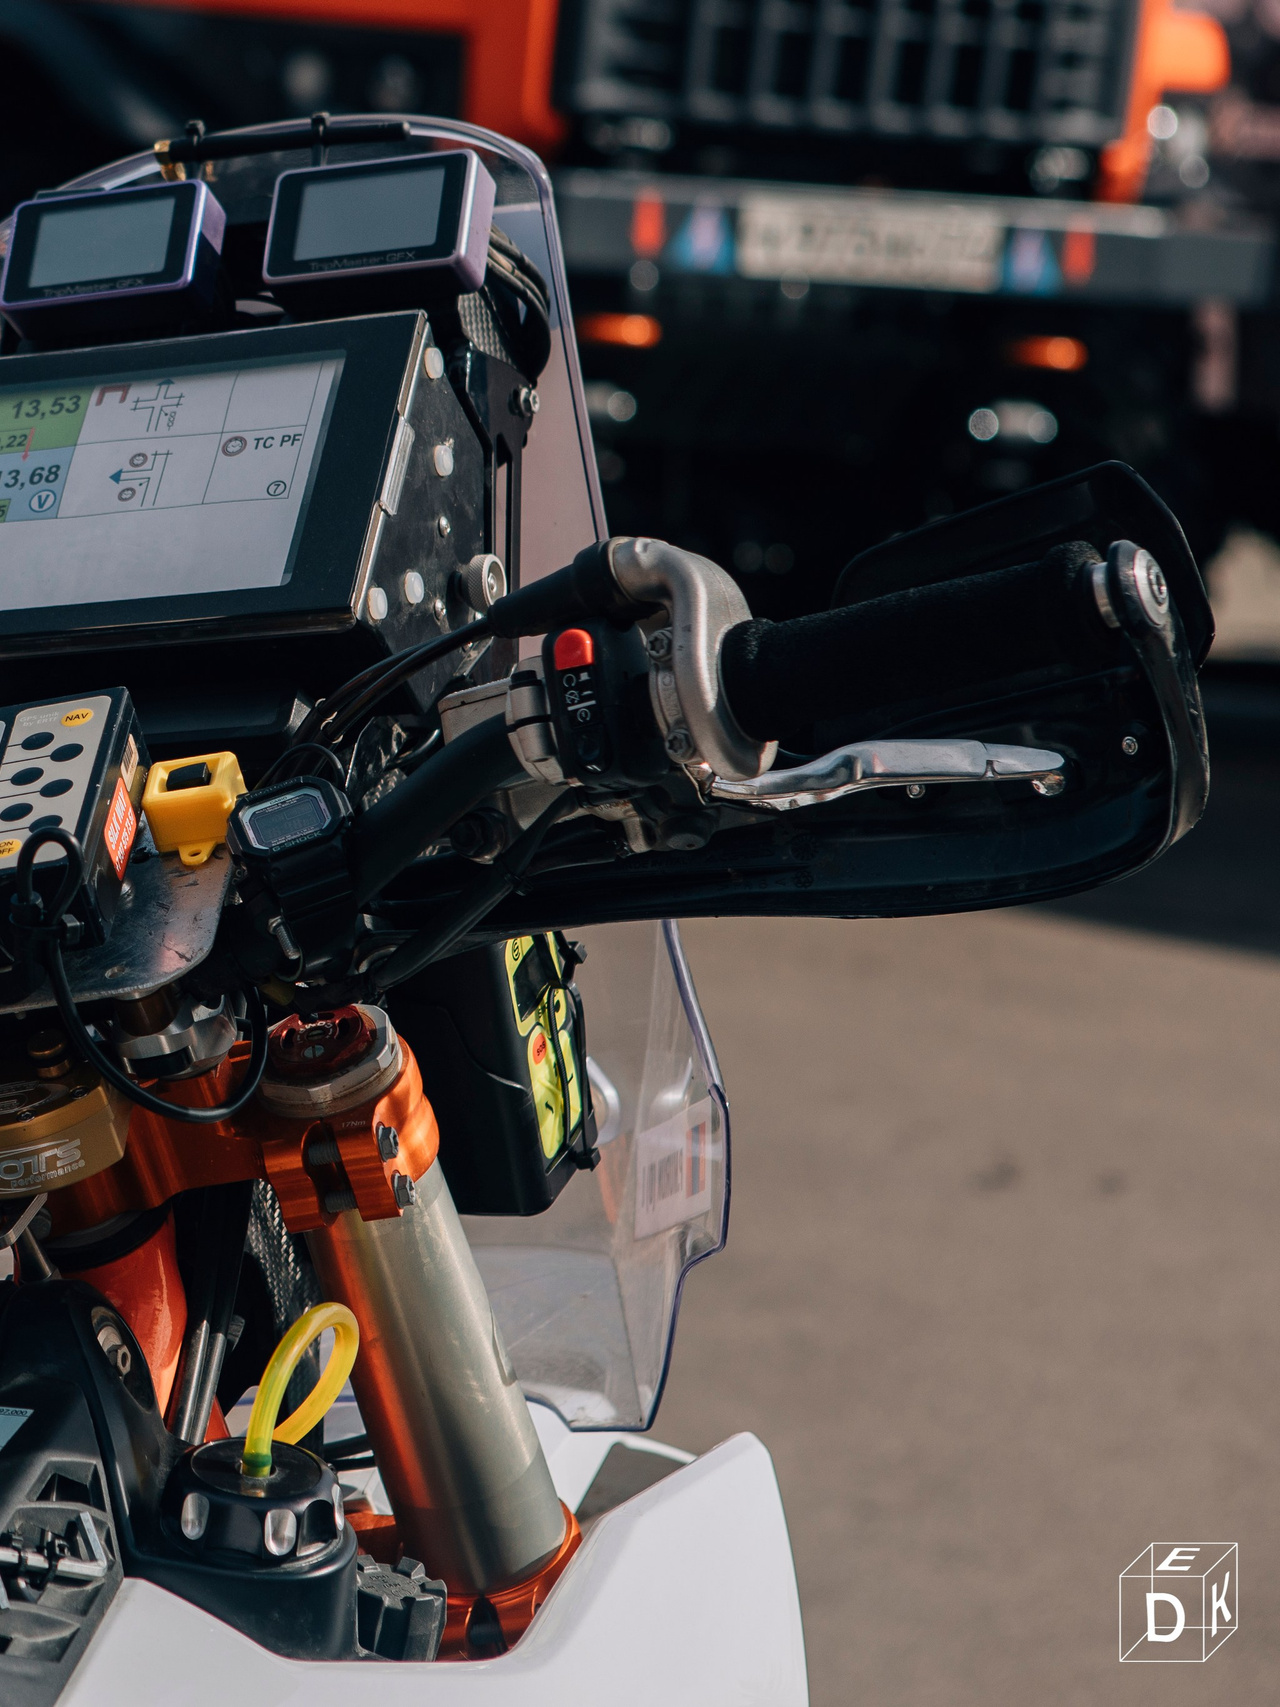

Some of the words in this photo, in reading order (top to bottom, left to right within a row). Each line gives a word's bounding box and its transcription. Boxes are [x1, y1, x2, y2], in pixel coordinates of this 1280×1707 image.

[386, 250, 416, 262] GFX
[12, 394, 82, 420] 13,53
[253, 436, 275, 450] TC
[280, 433, 302, 447] PF
[65, 712, 89, 722] NAV
[272, 830, 322, 852] G-SHOCK
[536, 1041, 546, 1056] SOS
[341, 1120, 366, 1128] 17Nm
[10, 1160, 86, 1188] performance
